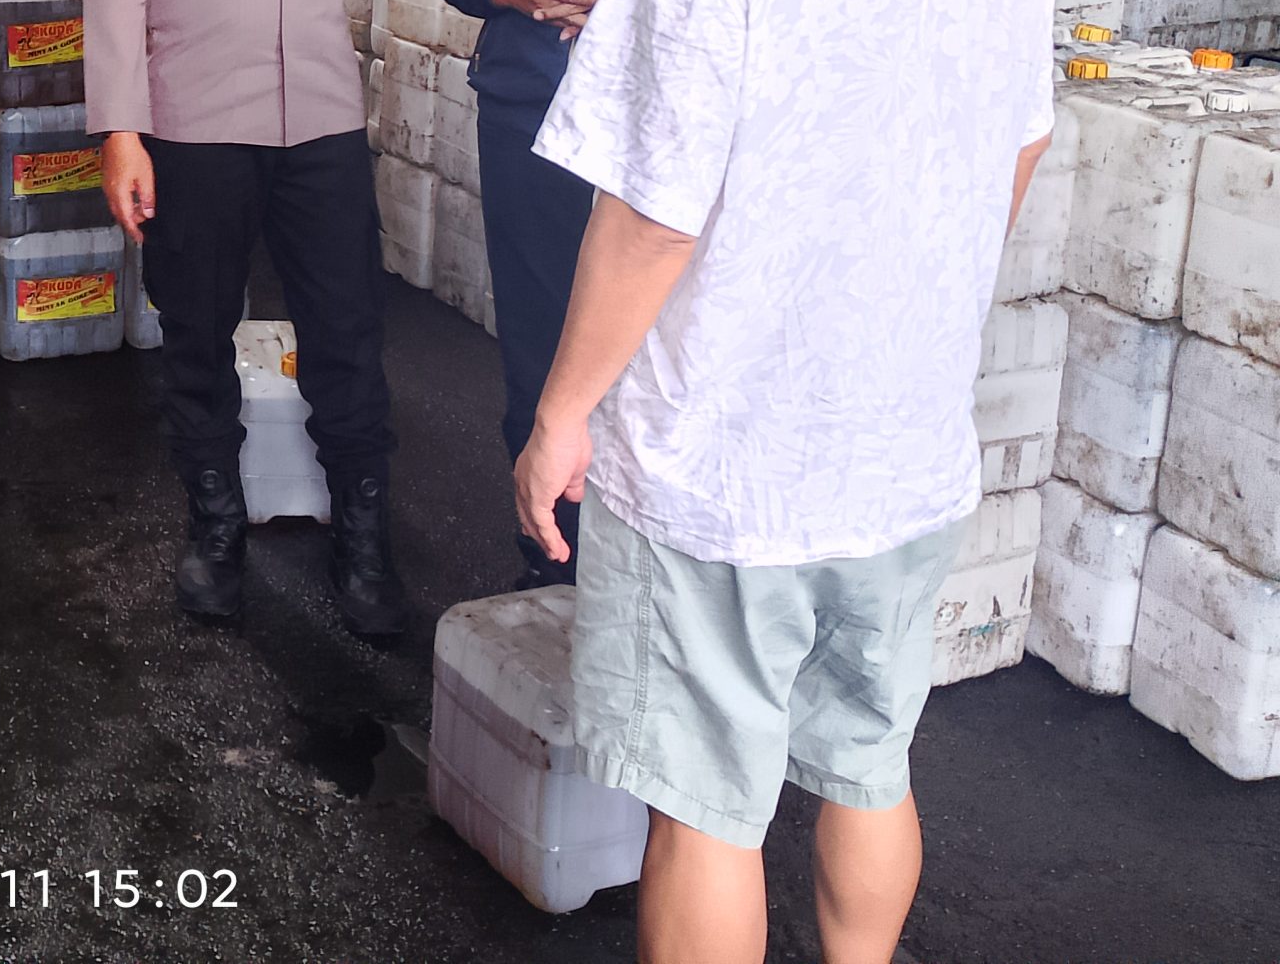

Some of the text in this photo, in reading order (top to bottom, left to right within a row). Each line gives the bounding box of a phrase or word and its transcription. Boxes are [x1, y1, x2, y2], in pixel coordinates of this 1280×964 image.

[41, 24, 73, 36] KUDA
[46, 155, 79, 166] KUDA
[48, 280, 82, 291] KUDA
[36, 287, 98, 313] MINYAK GORENG
